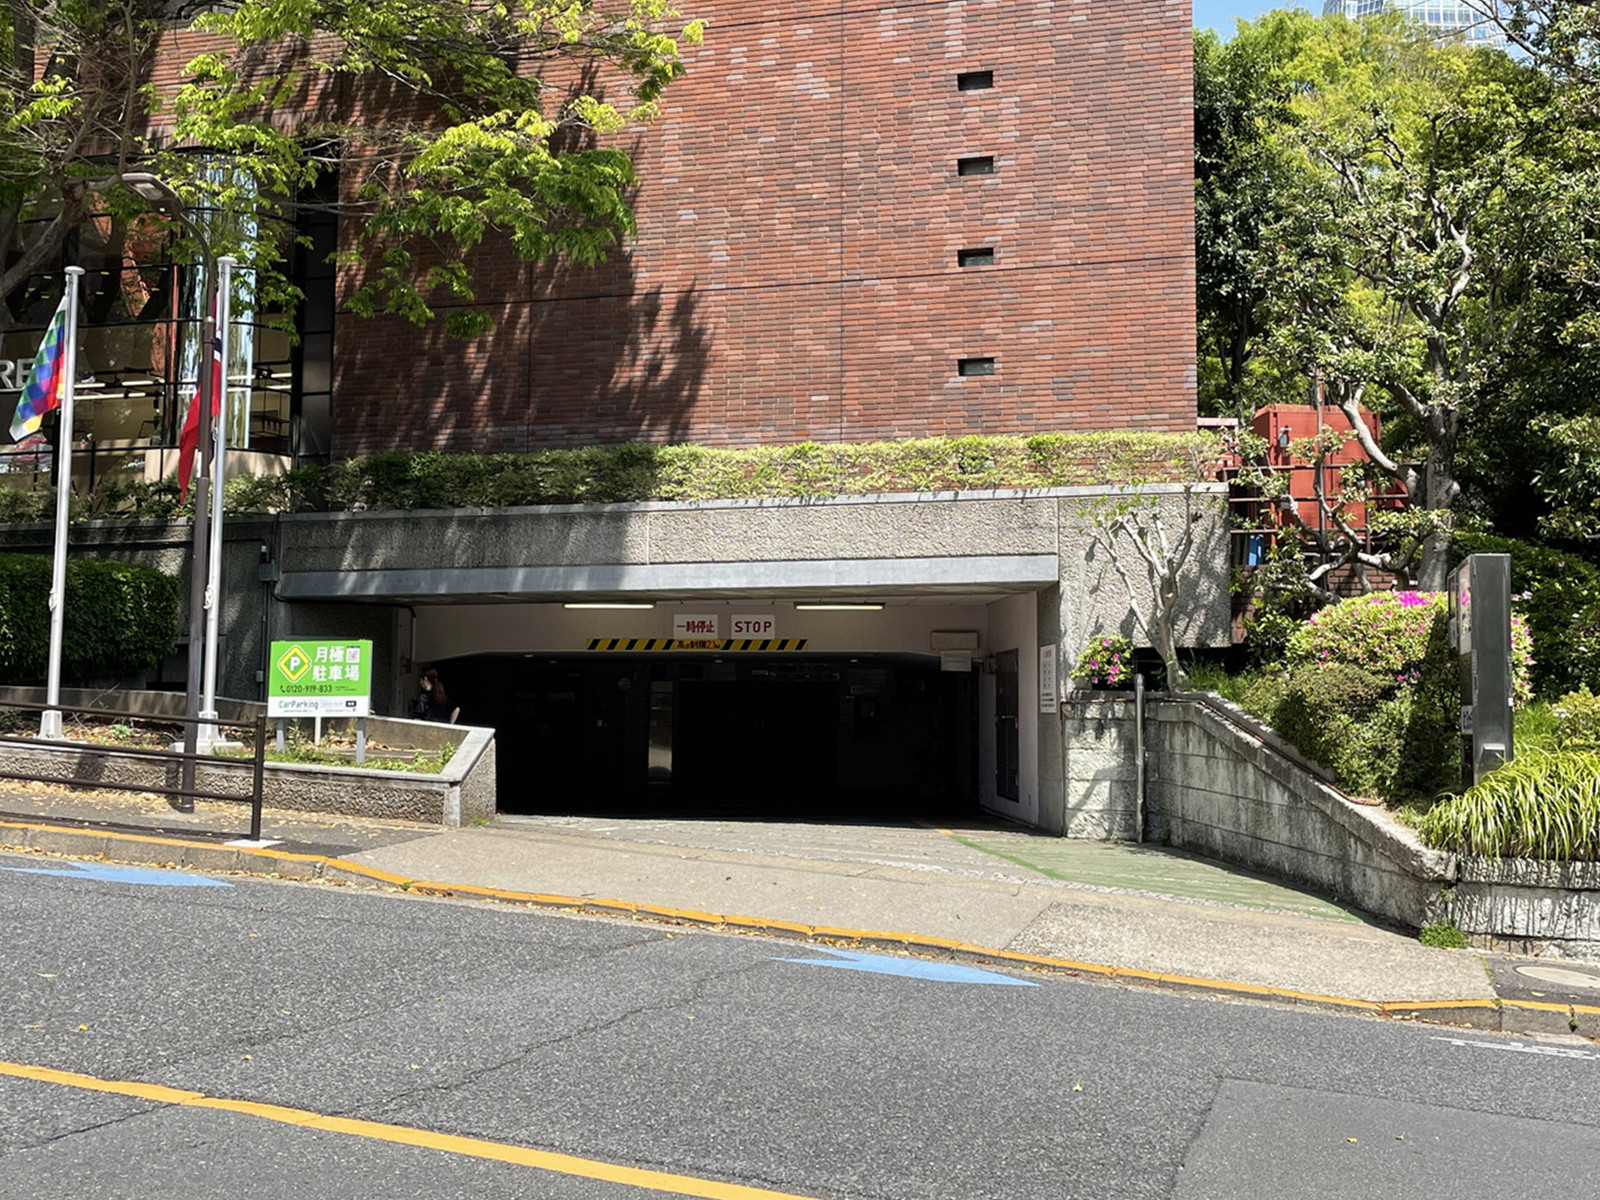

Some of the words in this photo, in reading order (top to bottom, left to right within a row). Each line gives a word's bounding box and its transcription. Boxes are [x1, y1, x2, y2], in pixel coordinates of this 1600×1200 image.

[676, 620, 716, 634] 一時停止
[734, 620, 772, 633] STOP
[314, 645, 345, 663] 月極
[289, 656, 301, 672] P
[312, 664, 360, 682] 駐車場
[285, 684, 333, 693] 0120-919-833
[278, 700, 319, 710] CarParking
